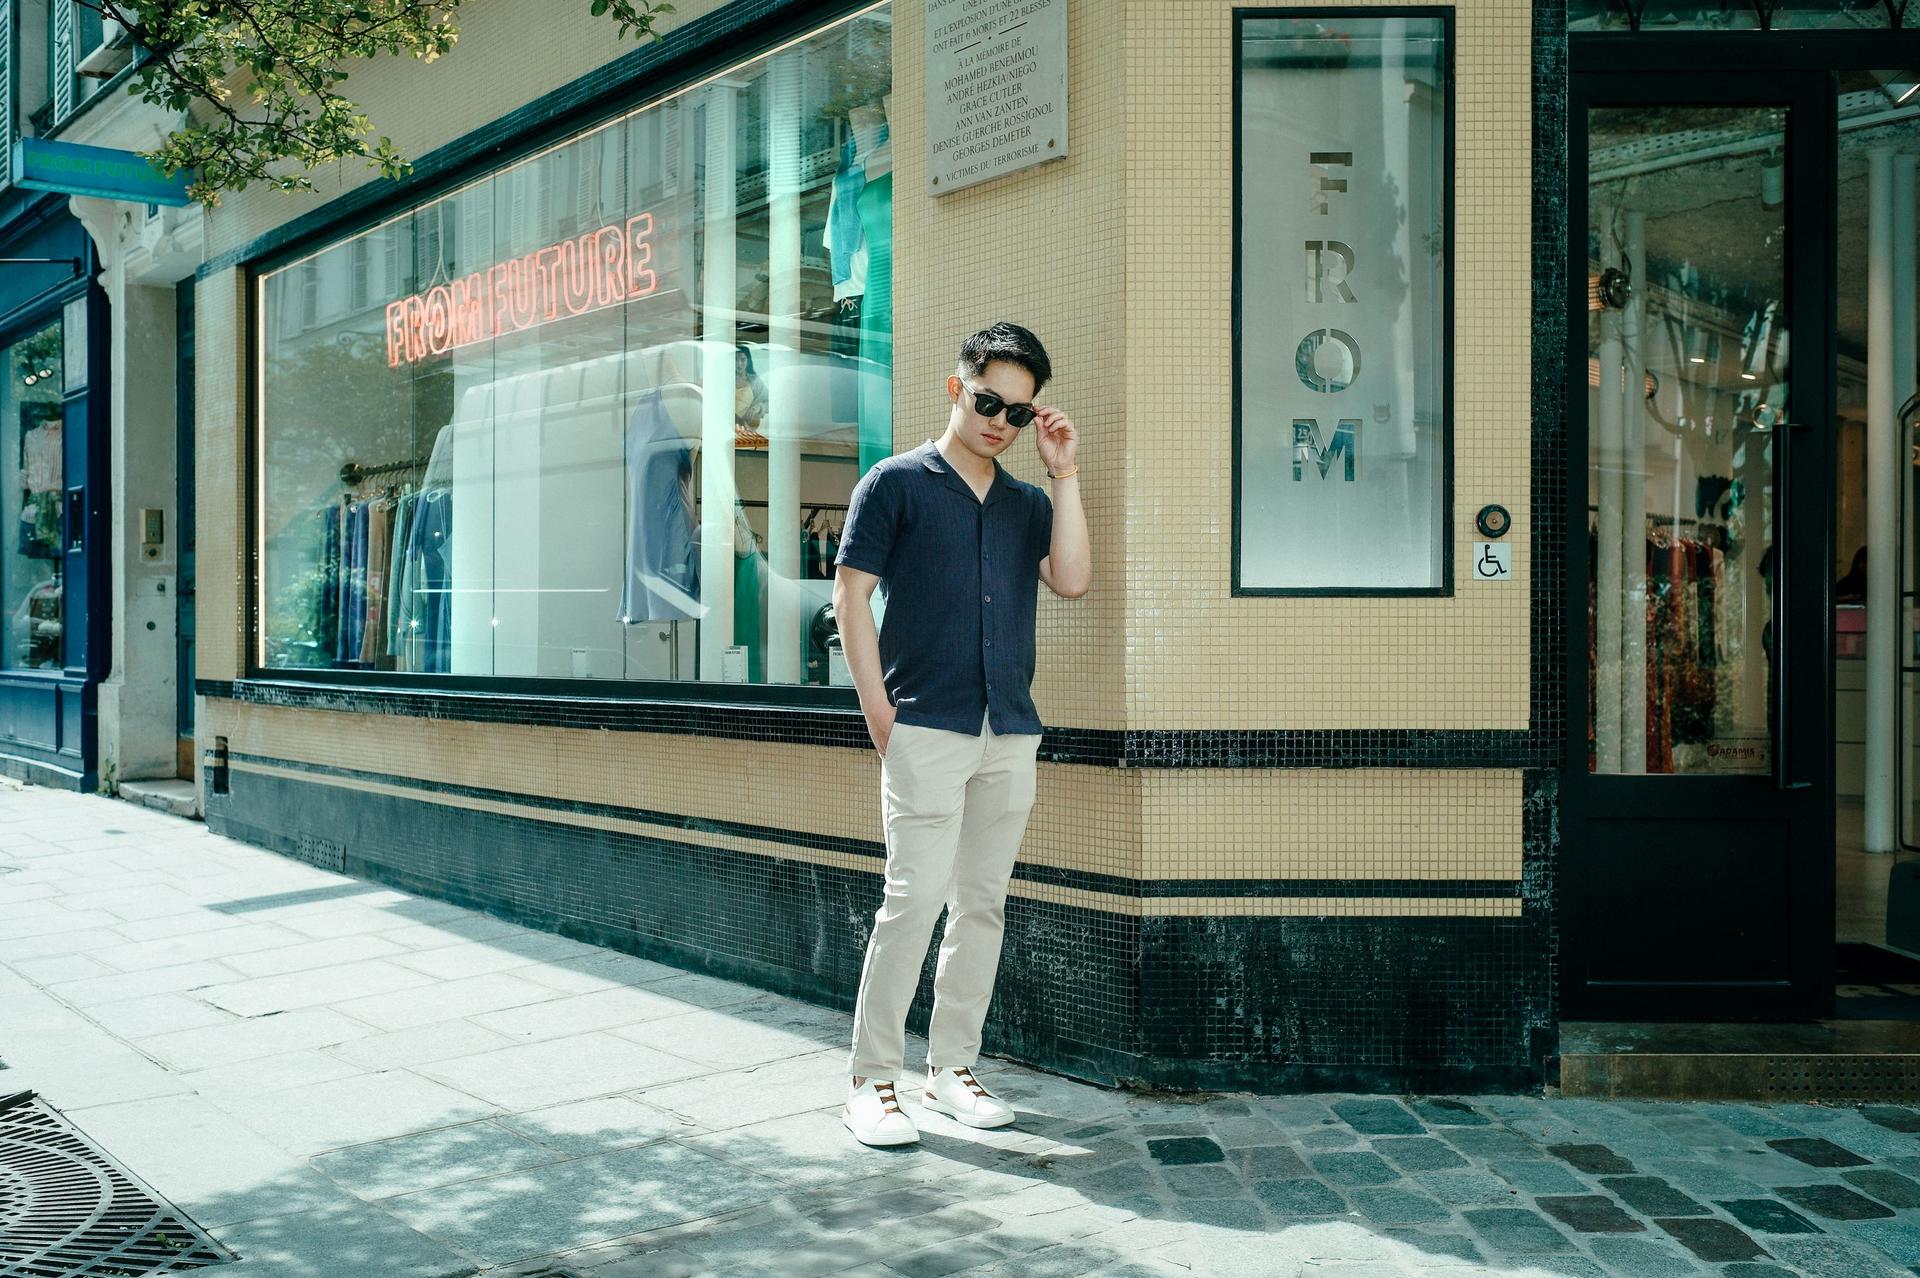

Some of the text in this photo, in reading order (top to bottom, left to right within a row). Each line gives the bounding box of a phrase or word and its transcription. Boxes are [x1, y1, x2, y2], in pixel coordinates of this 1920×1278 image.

[933, 40, 948, 54] ONT
[949, 33, 964, 47] FAIT
[965, 30, 971, 41] 6
[972, 20, 997, 37] MORTS
[998, 14, 1008, 27] ET
[1010, 8, 1020, 22] 22
[934, 28, 943, 39] ET
[944, 9, 988, 35] L'EXPLOSION
[944, 45, 1039, 92] MOHAMED BENEMMOU
[965, 56, 975, 67] LA
[1011, 36, 1022, 49] DE
[946, 81, 975, 105] ANDRÉ
[959, 82, 1023, 115] GRACE CUTLER
[933, 102, 1054, 154] DENISE GUERCHE ROSSIGNOL
[955, 95, 1029, 132] ANN VAN ZANTEN
[952, 125, 1032, 162] GEORGES DEMETER
[26, 151, 91, 174] FROM
[946, 143, 1040, 182] VICTIMES DU TERRORISME
[386, 212, 657, 368] FROM FUTURE
[1292, 151, 1363, 482] FROM
